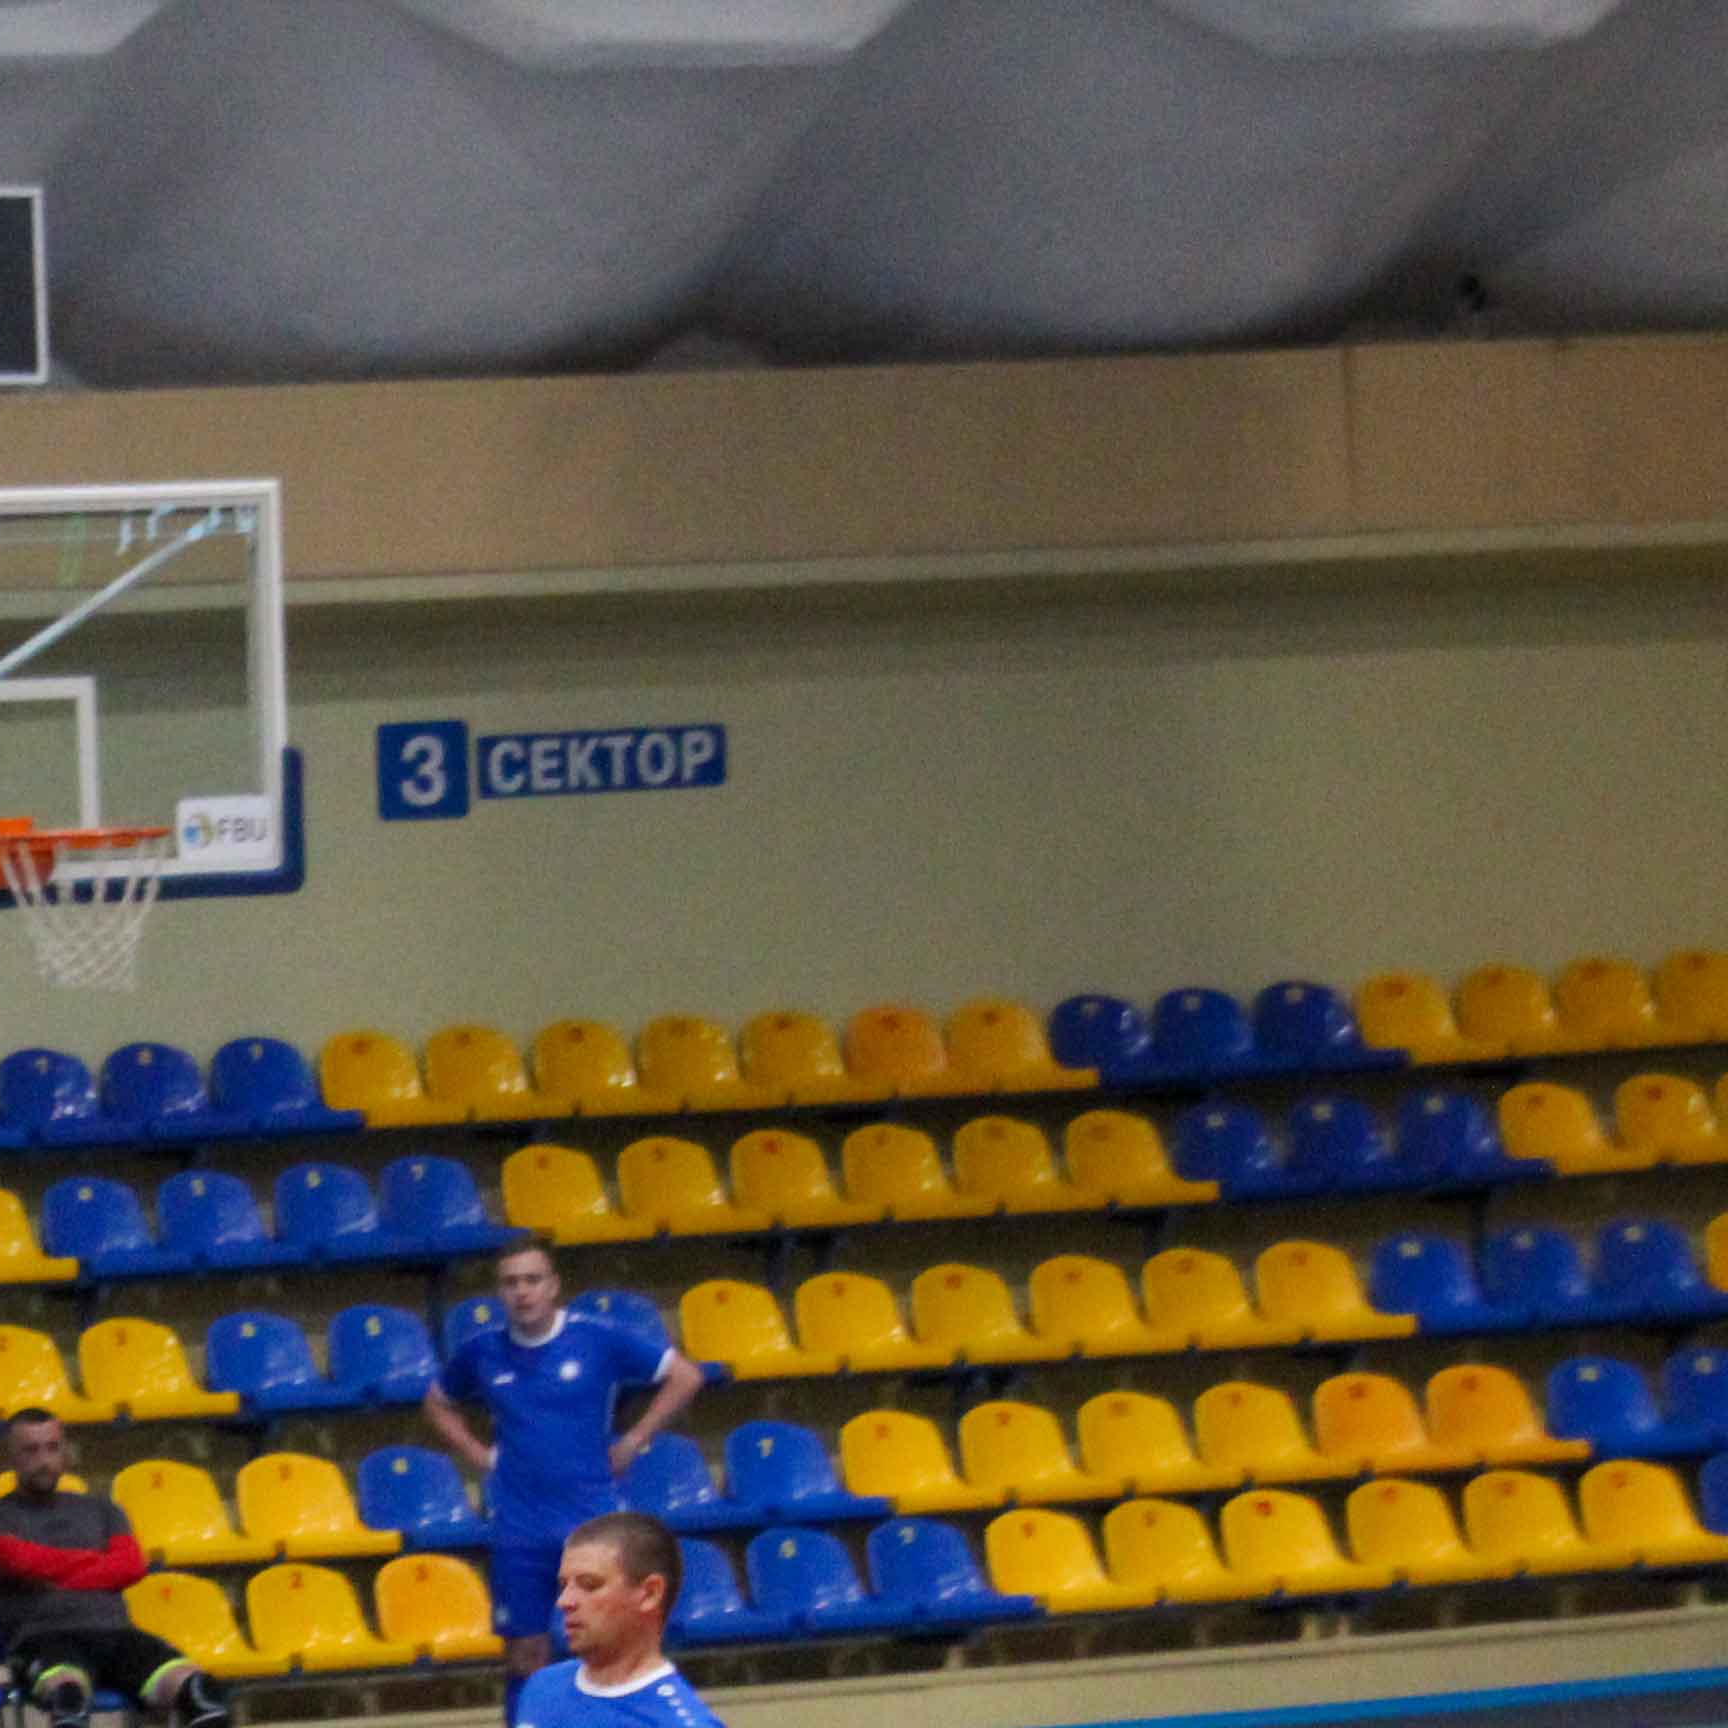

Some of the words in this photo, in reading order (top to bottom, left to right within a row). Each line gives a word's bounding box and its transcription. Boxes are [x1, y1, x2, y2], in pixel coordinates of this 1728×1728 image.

[399, 735, 447, 807] 3
[487, 730, 716, 793] СЕКТОР
[218, 817, 268, 842] FBU
